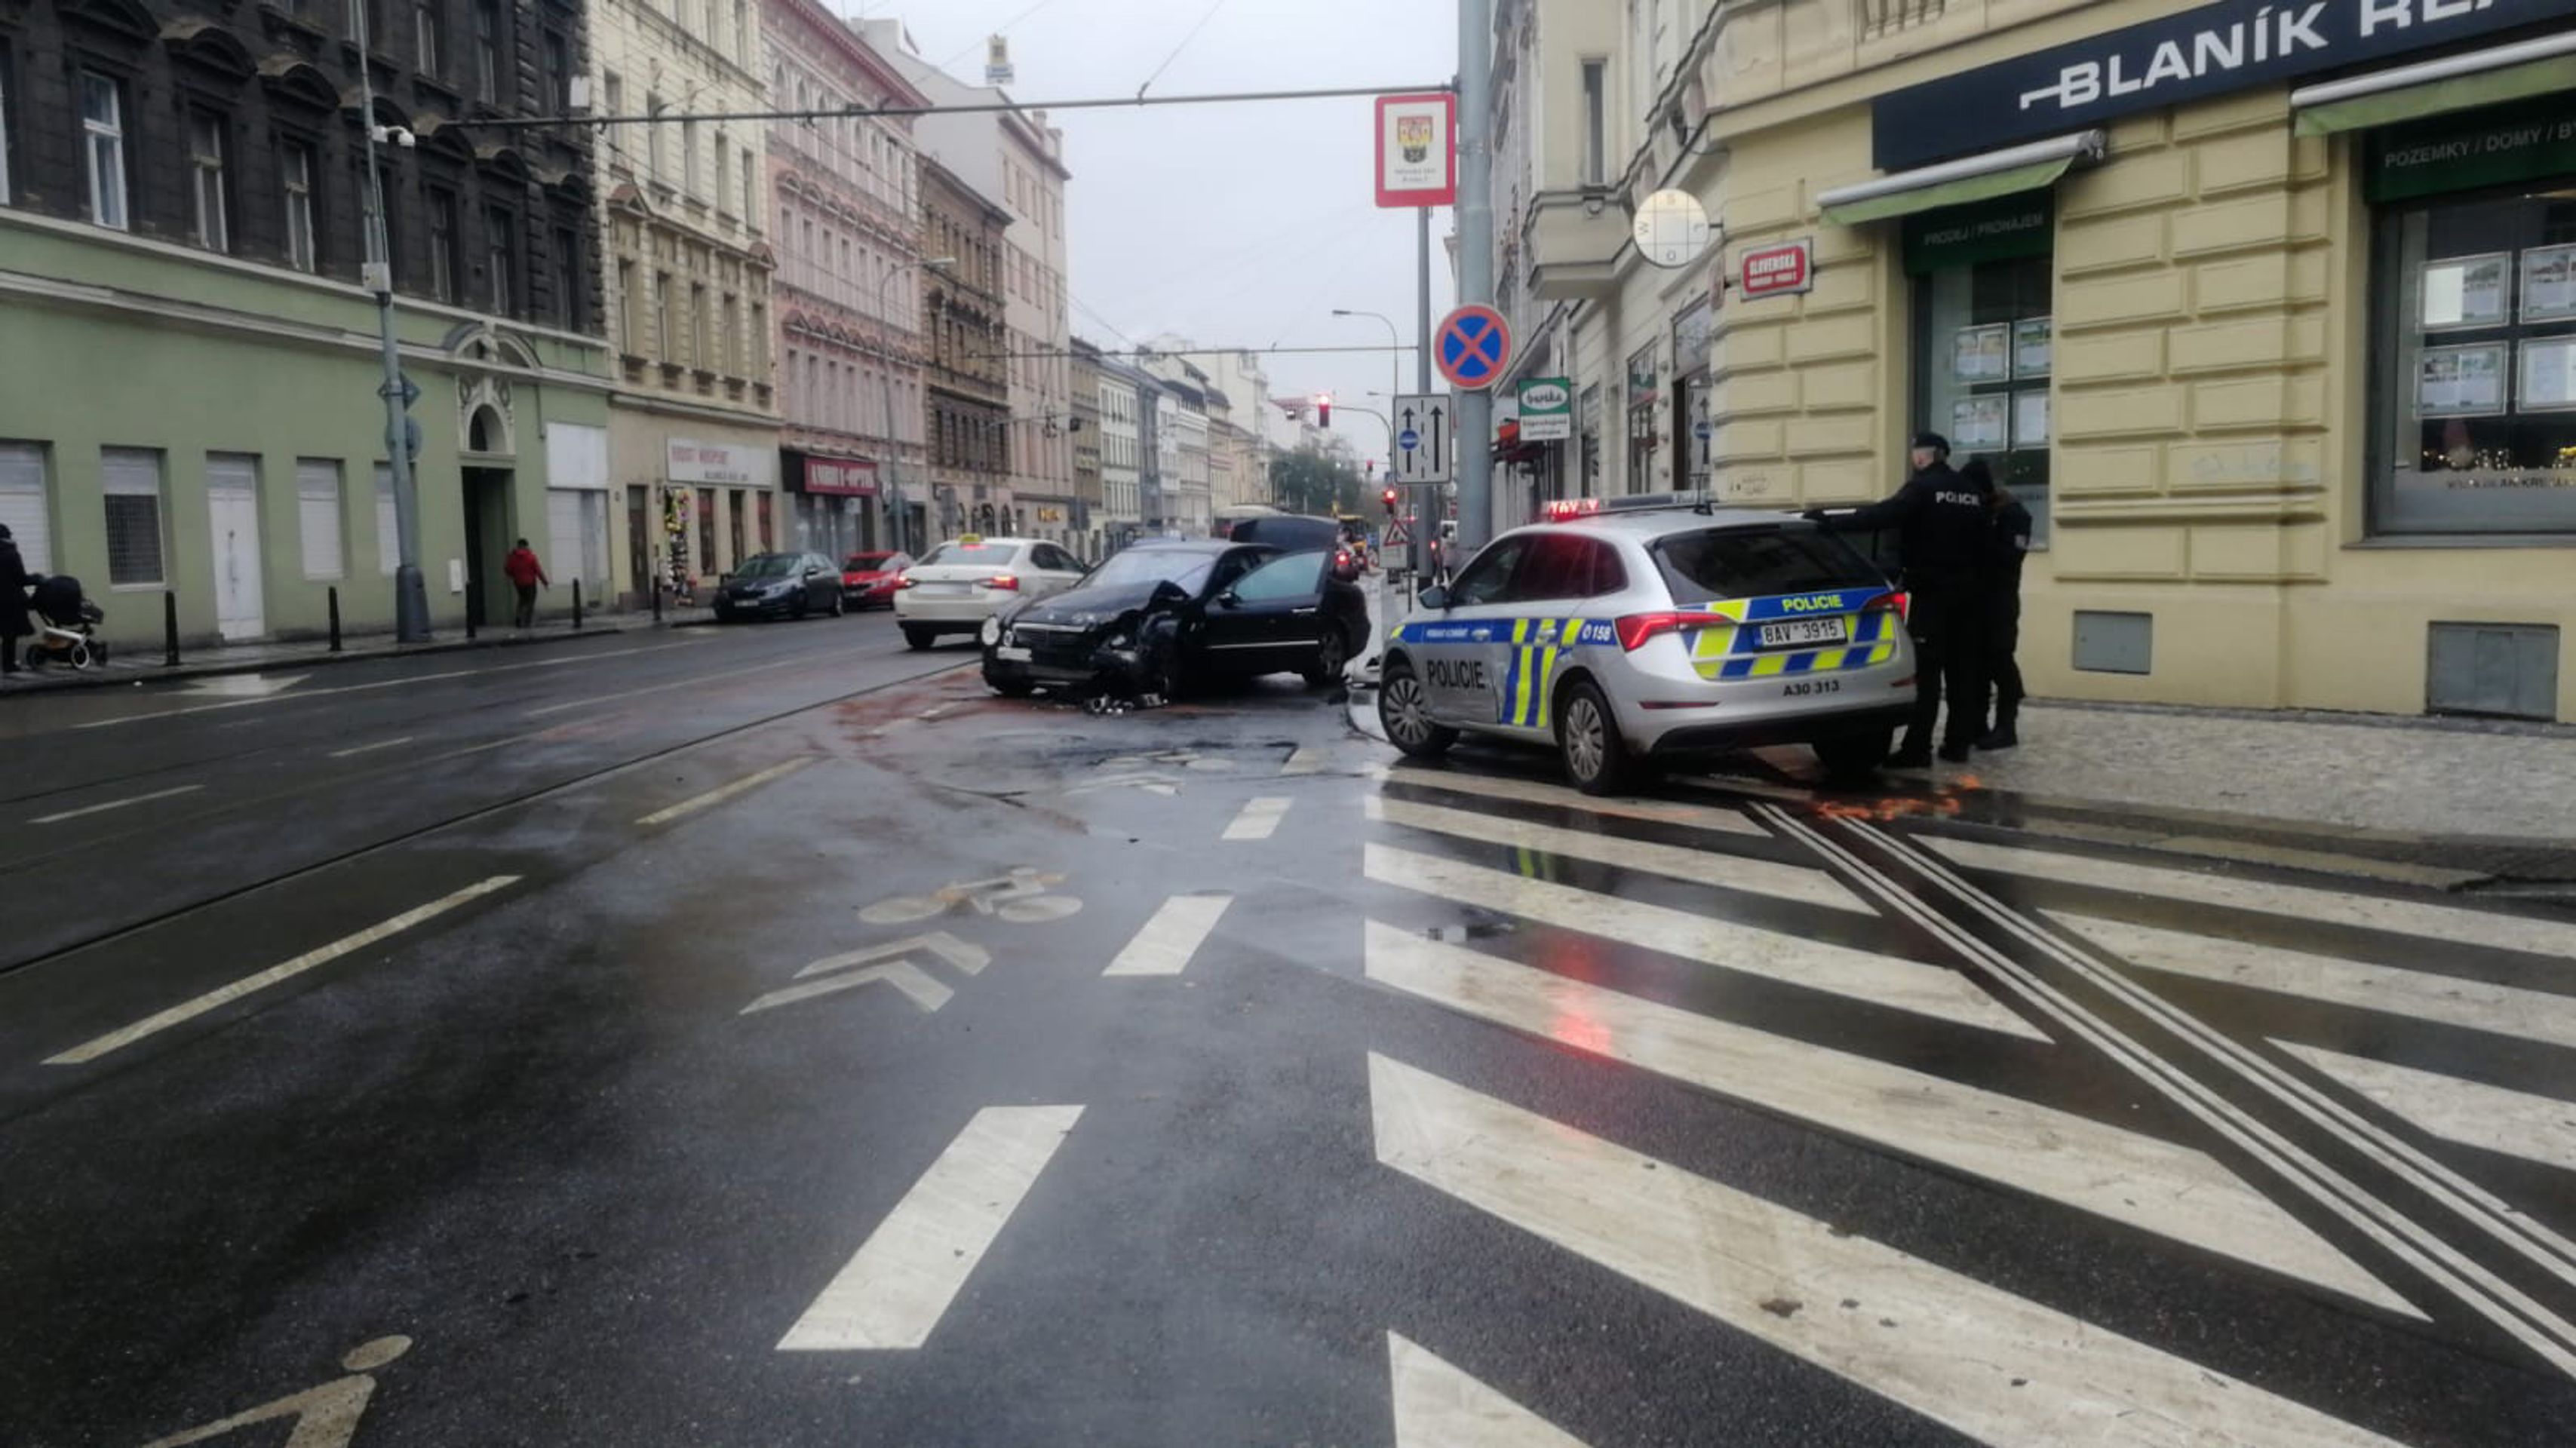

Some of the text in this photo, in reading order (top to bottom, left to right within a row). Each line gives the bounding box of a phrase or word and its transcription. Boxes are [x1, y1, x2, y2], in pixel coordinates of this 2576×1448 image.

[2059, 2, 2329, 109] BLANÍK
[2384, 141, 2470, 167] POZEMKY
[2487, 127, 2541, 152] DOMY
[2558, 121, 2576, 140] B
[1782, 594, 1844, 612] POLICIE
[1592, 624, 1611, 641] 158
[1802, 620, 1838, 640] 3915
[1426, 659, 1485, 689] POLICIE
[1783, 680, 1840, 697] A30 313
